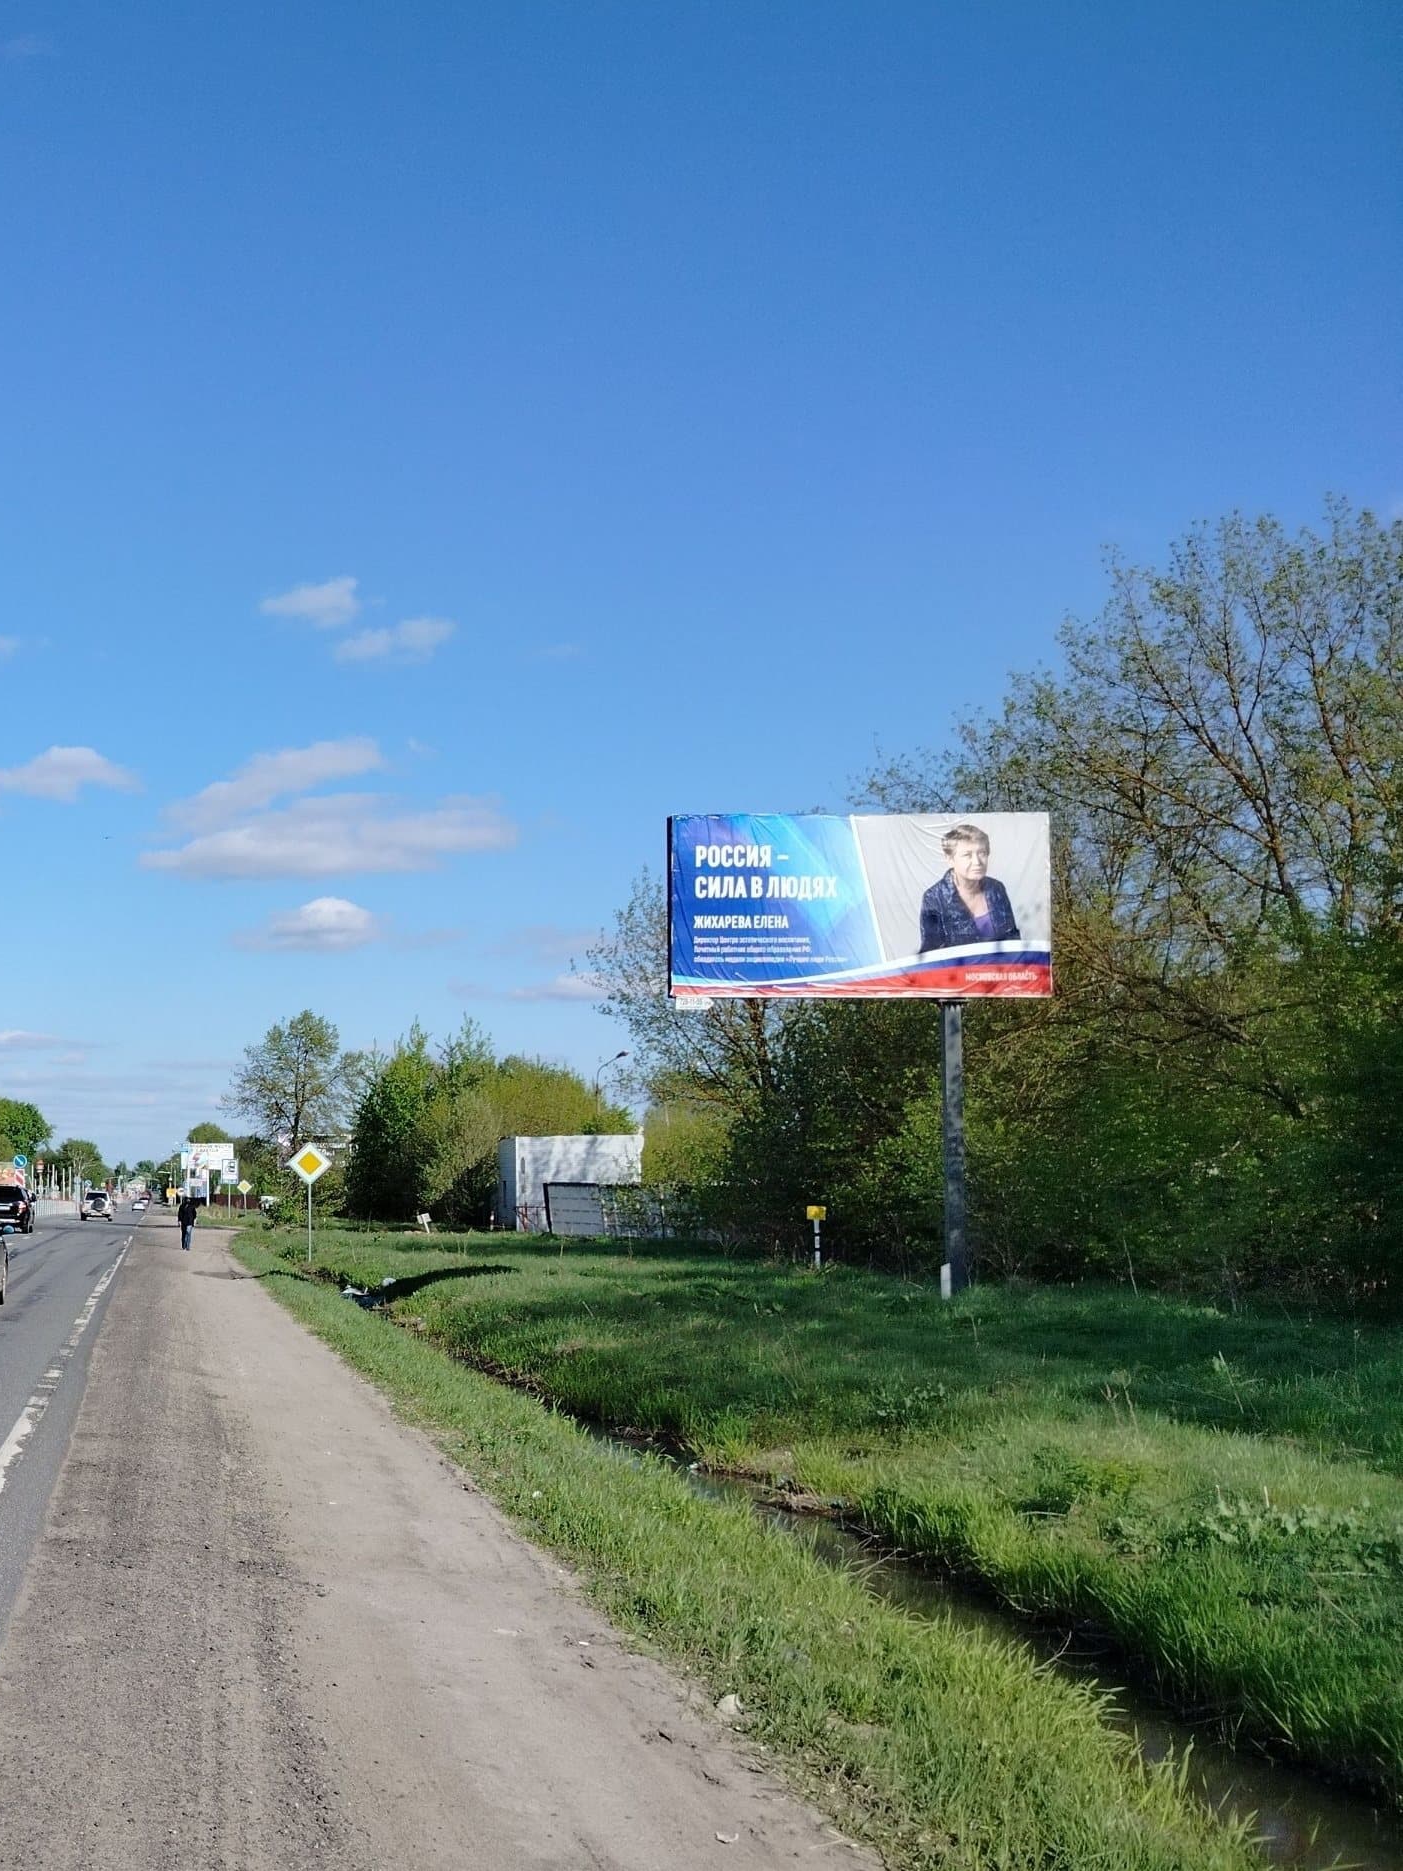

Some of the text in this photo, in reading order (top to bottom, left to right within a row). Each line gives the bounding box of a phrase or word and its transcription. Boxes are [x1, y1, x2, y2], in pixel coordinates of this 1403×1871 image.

[695, 845, 772, 868] РОССИЯ
[695, 875, 838, 900] СИЛА В ЛЮДЯХ
[693, 915, 789, 929] ЖИХАРЕВА ЕЛЕНА
